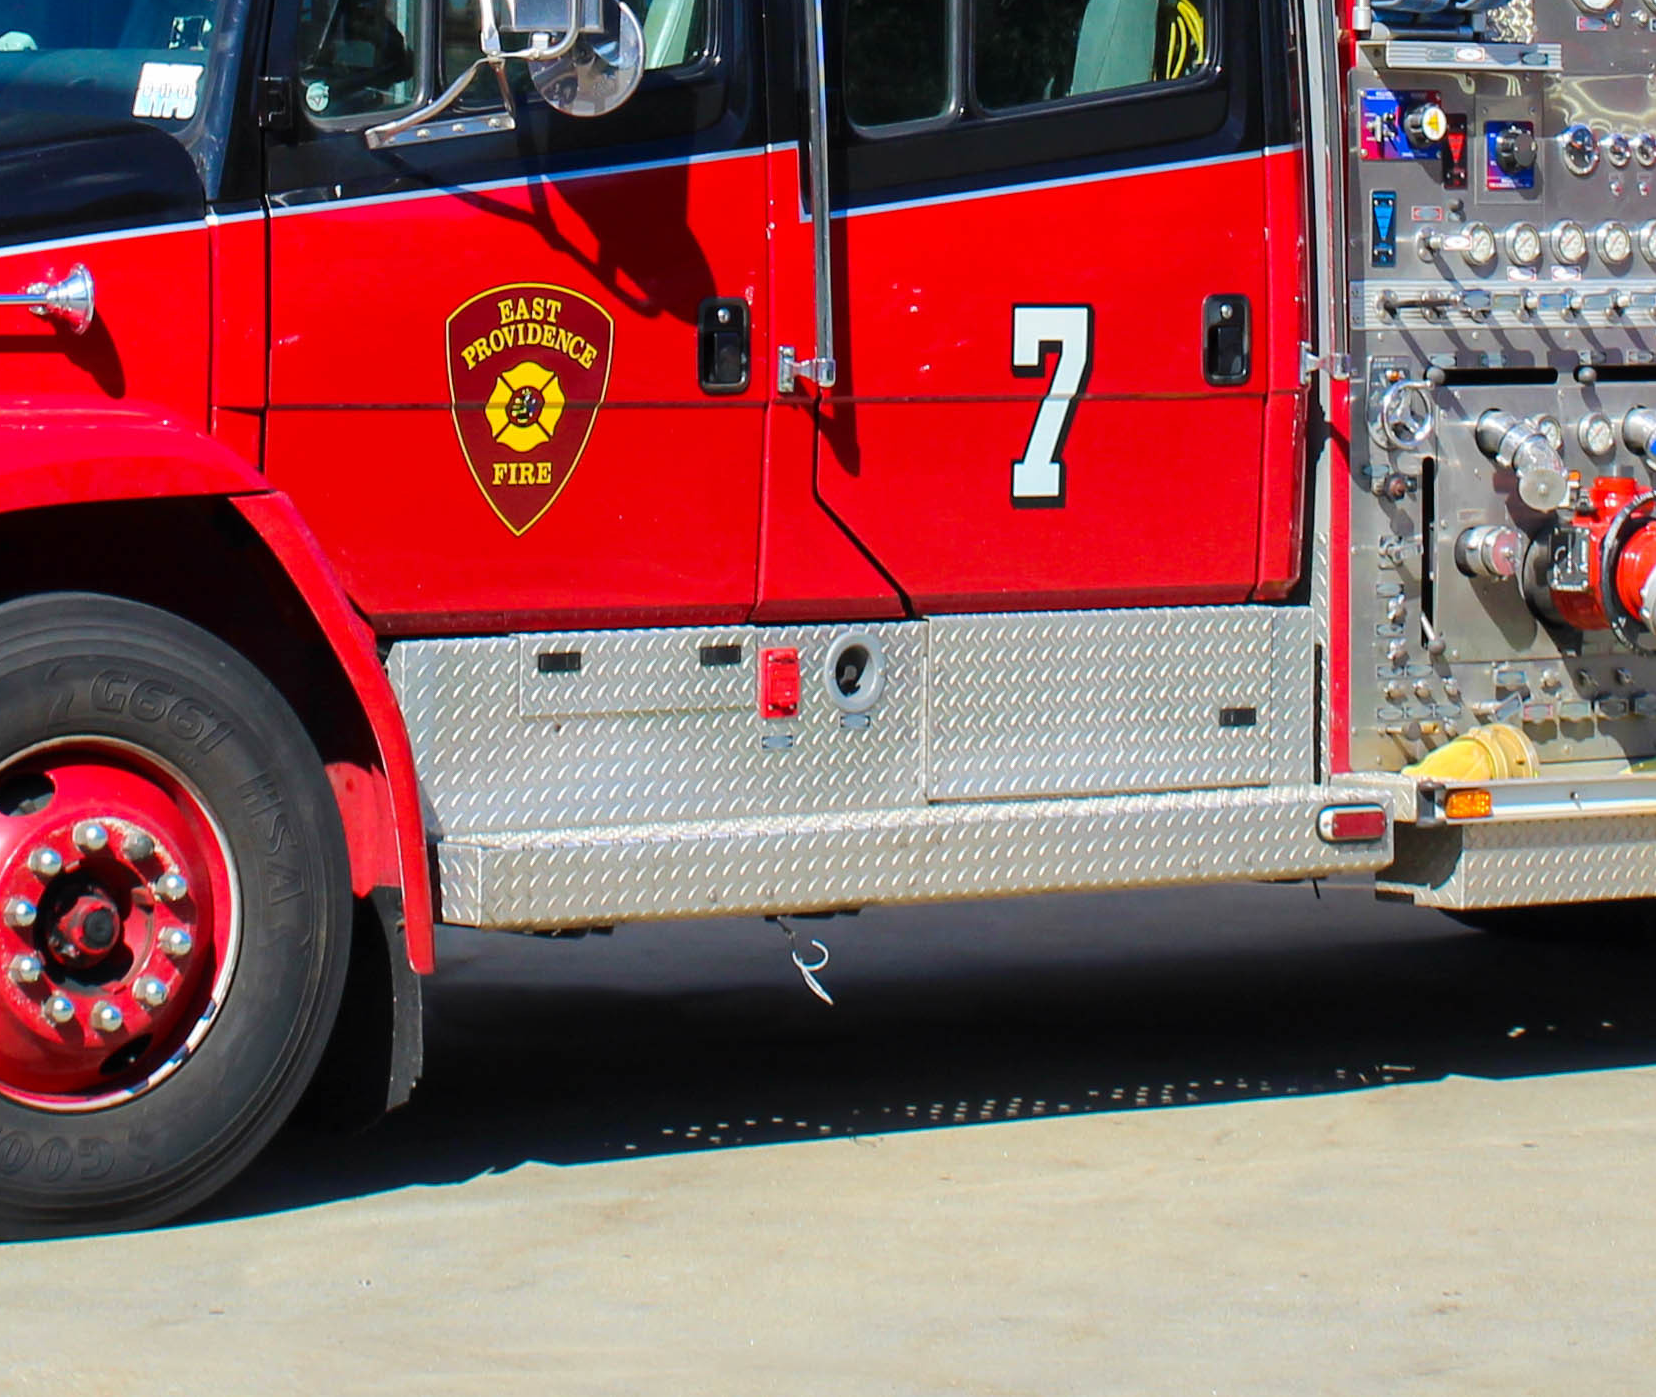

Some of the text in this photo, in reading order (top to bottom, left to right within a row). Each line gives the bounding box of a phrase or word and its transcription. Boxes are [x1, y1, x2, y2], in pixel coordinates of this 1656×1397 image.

[496, 297, 563, 325] EAST
[461, 322, 598, 371] PROVIDENCE
[1011, 303, 1095, 510] 7
[492, 461, 552, 485] FIRE
[89, 668, 236, 756] G661
